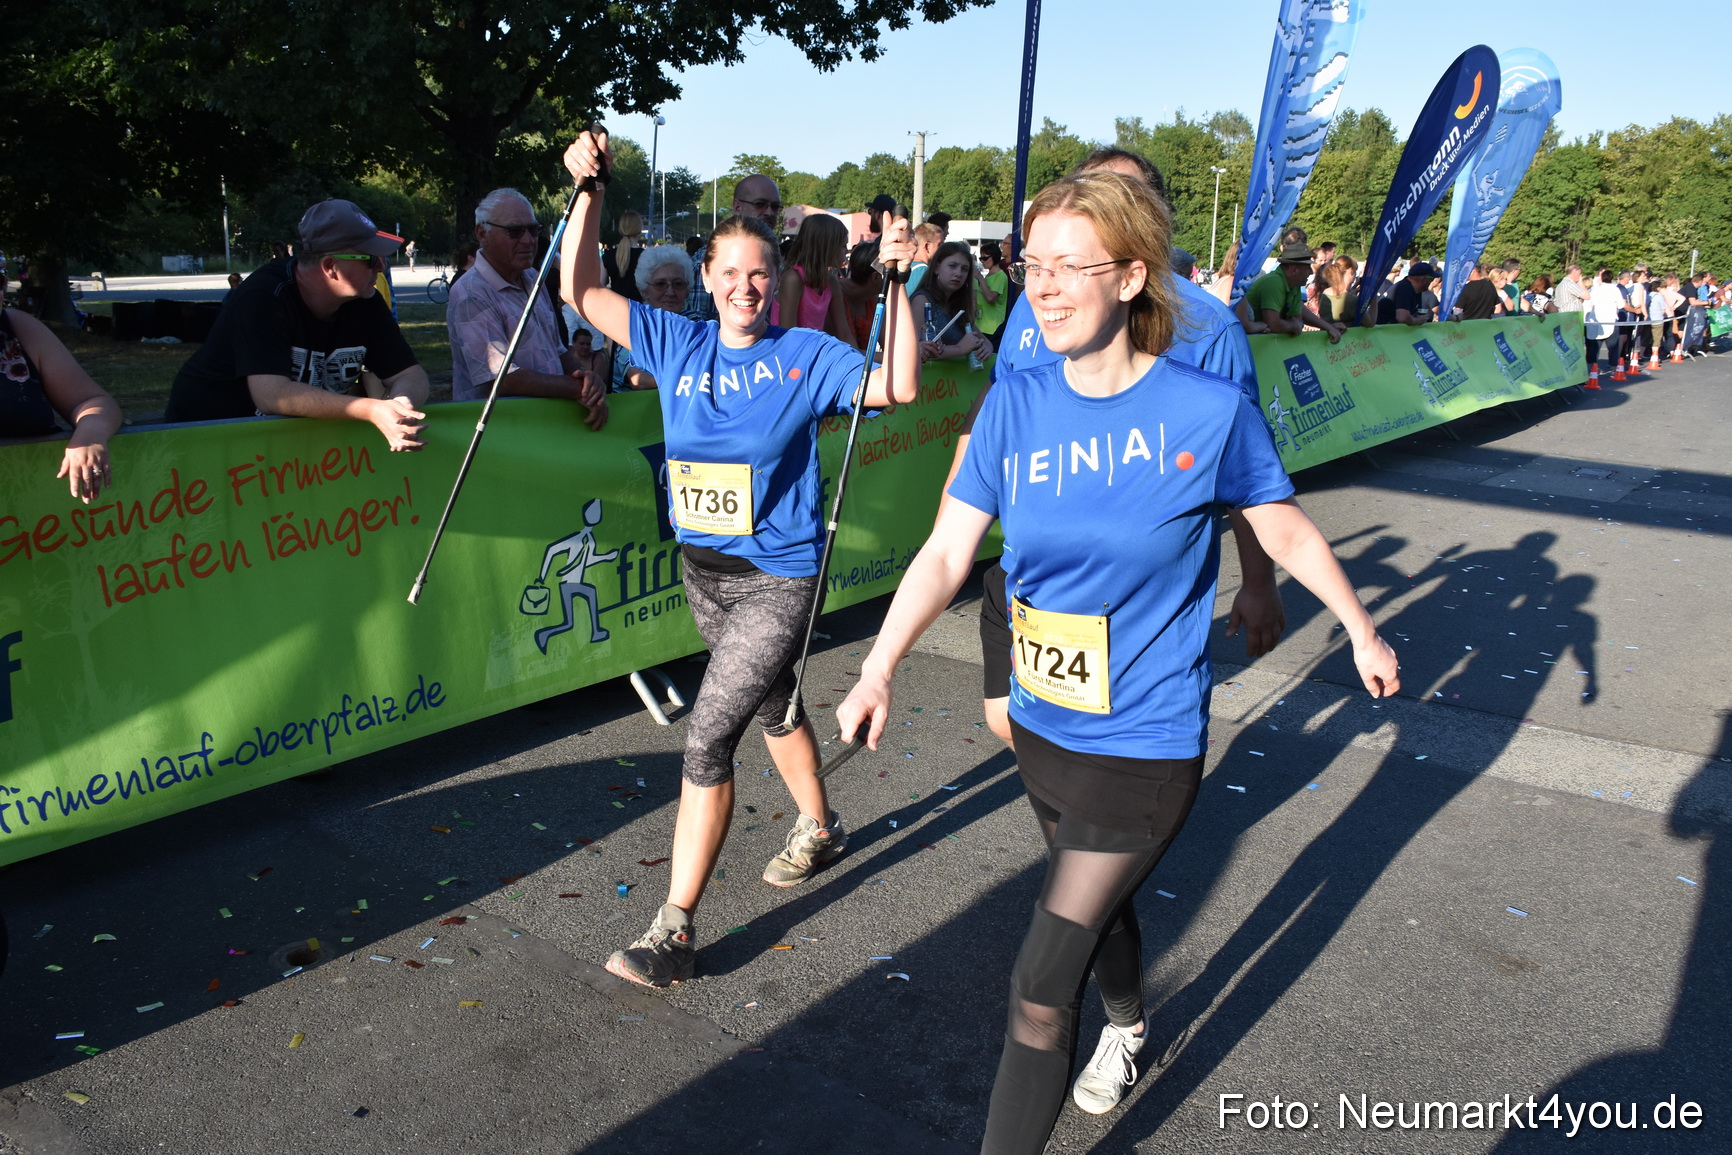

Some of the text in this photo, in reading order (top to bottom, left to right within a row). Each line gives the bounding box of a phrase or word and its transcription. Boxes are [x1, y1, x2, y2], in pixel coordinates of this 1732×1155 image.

[1429, 104, 1490, 192] Druck und Medien
[1383, 125, 1461, 244] Frischmann
[1289, 383, 1354, 436] firmenlauf
[857, 425, 913, 467] laufen
[1302, 424, 1332, 445] neumarkt
[228, 446, 375, 506] Firmen
[680, 486, 738, 515] 1736
[98, 477, 420, 608] laufen länger!
[711, 515, 733, 523] Carina
[1018, 635, 1090, 684] 1724
[1045, 678, 1075, 693] Martina
